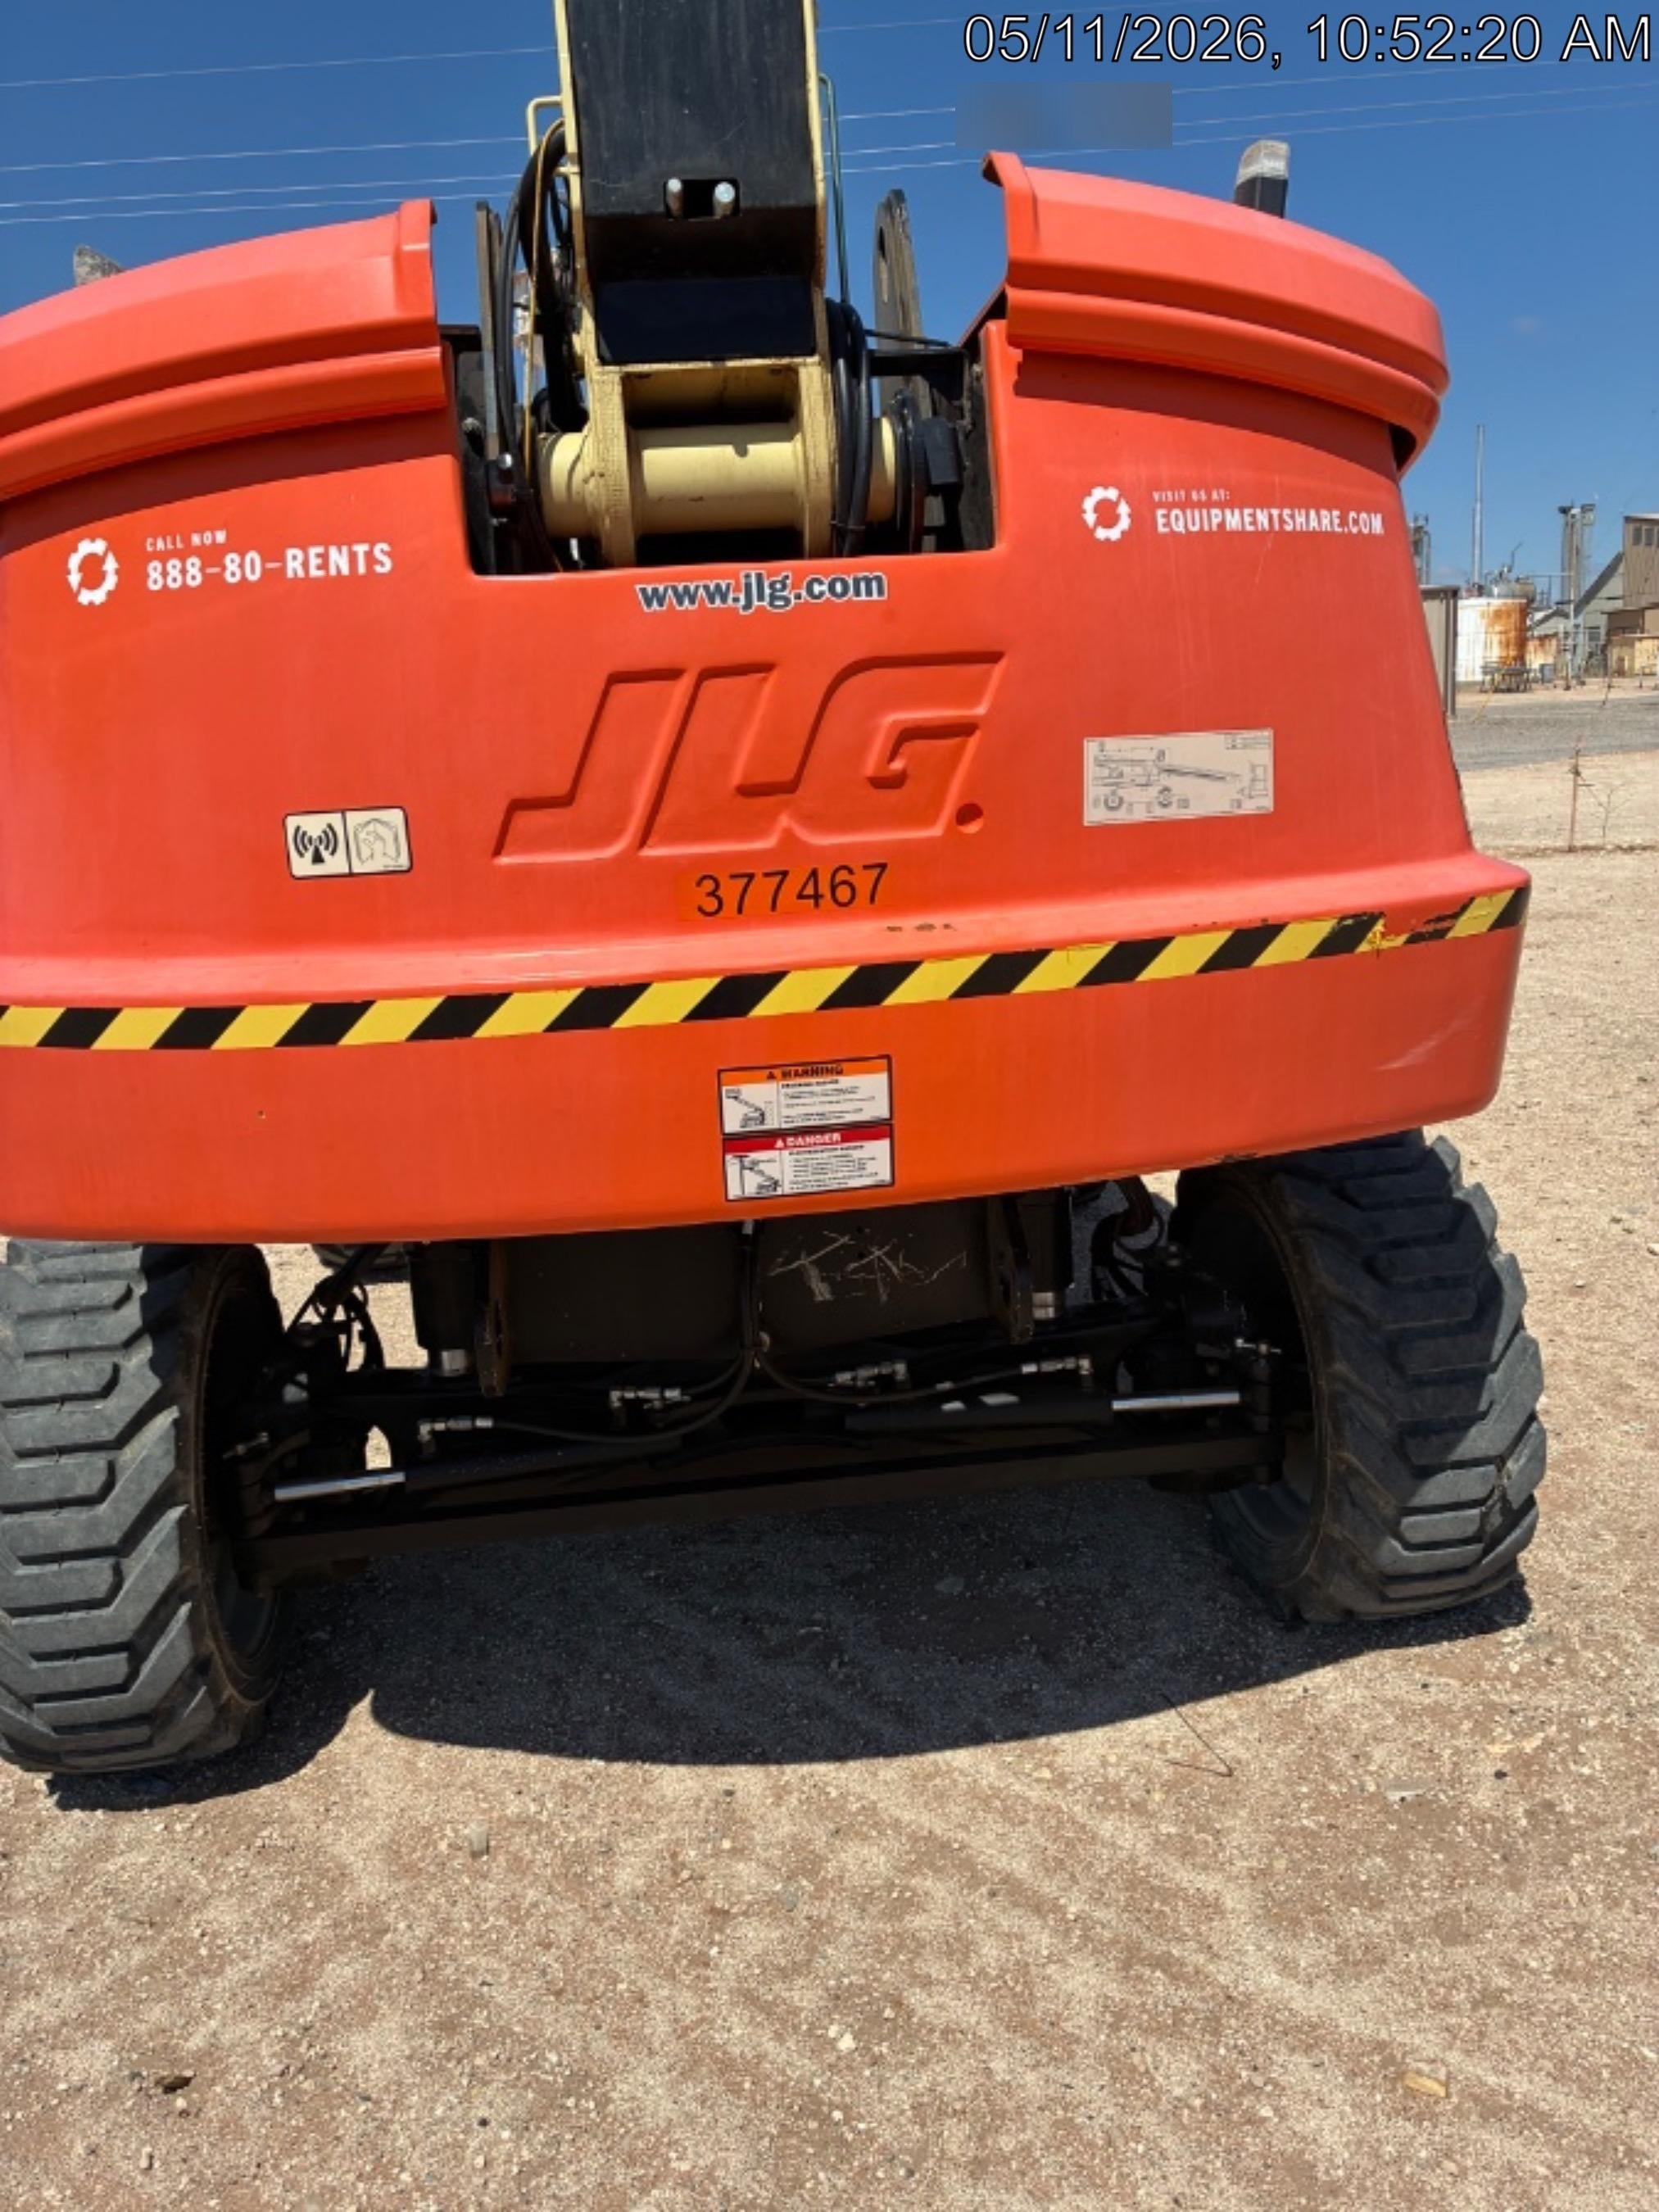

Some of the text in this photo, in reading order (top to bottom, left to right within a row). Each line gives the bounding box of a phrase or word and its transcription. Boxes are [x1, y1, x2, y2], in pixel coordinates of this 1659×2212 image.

[1152, 490, 1186, 502] VISIT
[1155, 507, 1385, 535] EQUIPMENTSHARE.COM
[146, 529, 228, 552] CALL NOW
[146, 542, 393, 592] 888-80-RENTS
[636, 571, 887, 614] www.jlg.com
[696, 862, 889, 918] 377467
[786, 1132, 841, 1147] DANGER
